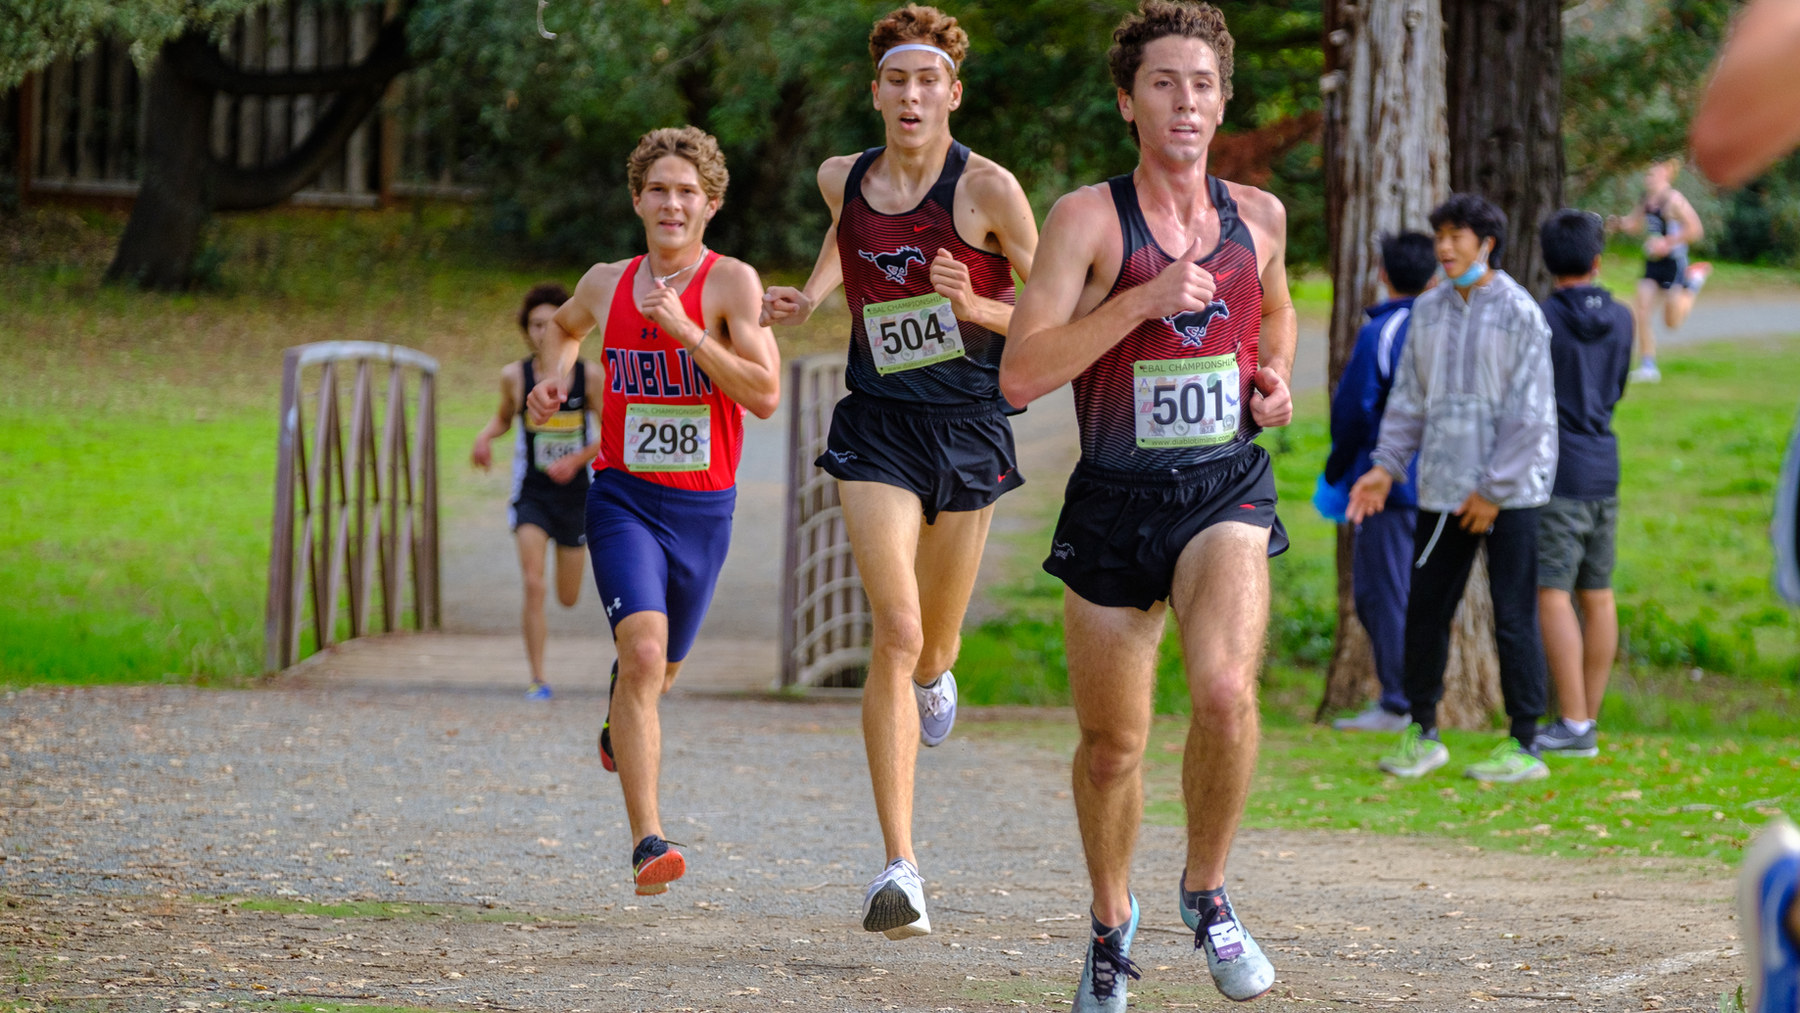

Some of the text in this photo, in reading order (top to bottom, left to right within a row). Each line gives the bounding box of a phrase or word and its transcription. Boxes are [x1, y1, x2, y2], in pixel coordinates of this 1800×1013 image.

[880, 313, 946, 354] 504
[605, 347, 713, 397] DUBLIN
[1153, 380, 1223, 425] 501
[638, 423, 699, 455] 298
[1152, 434, 1231, 446] www.diablotiming.com
